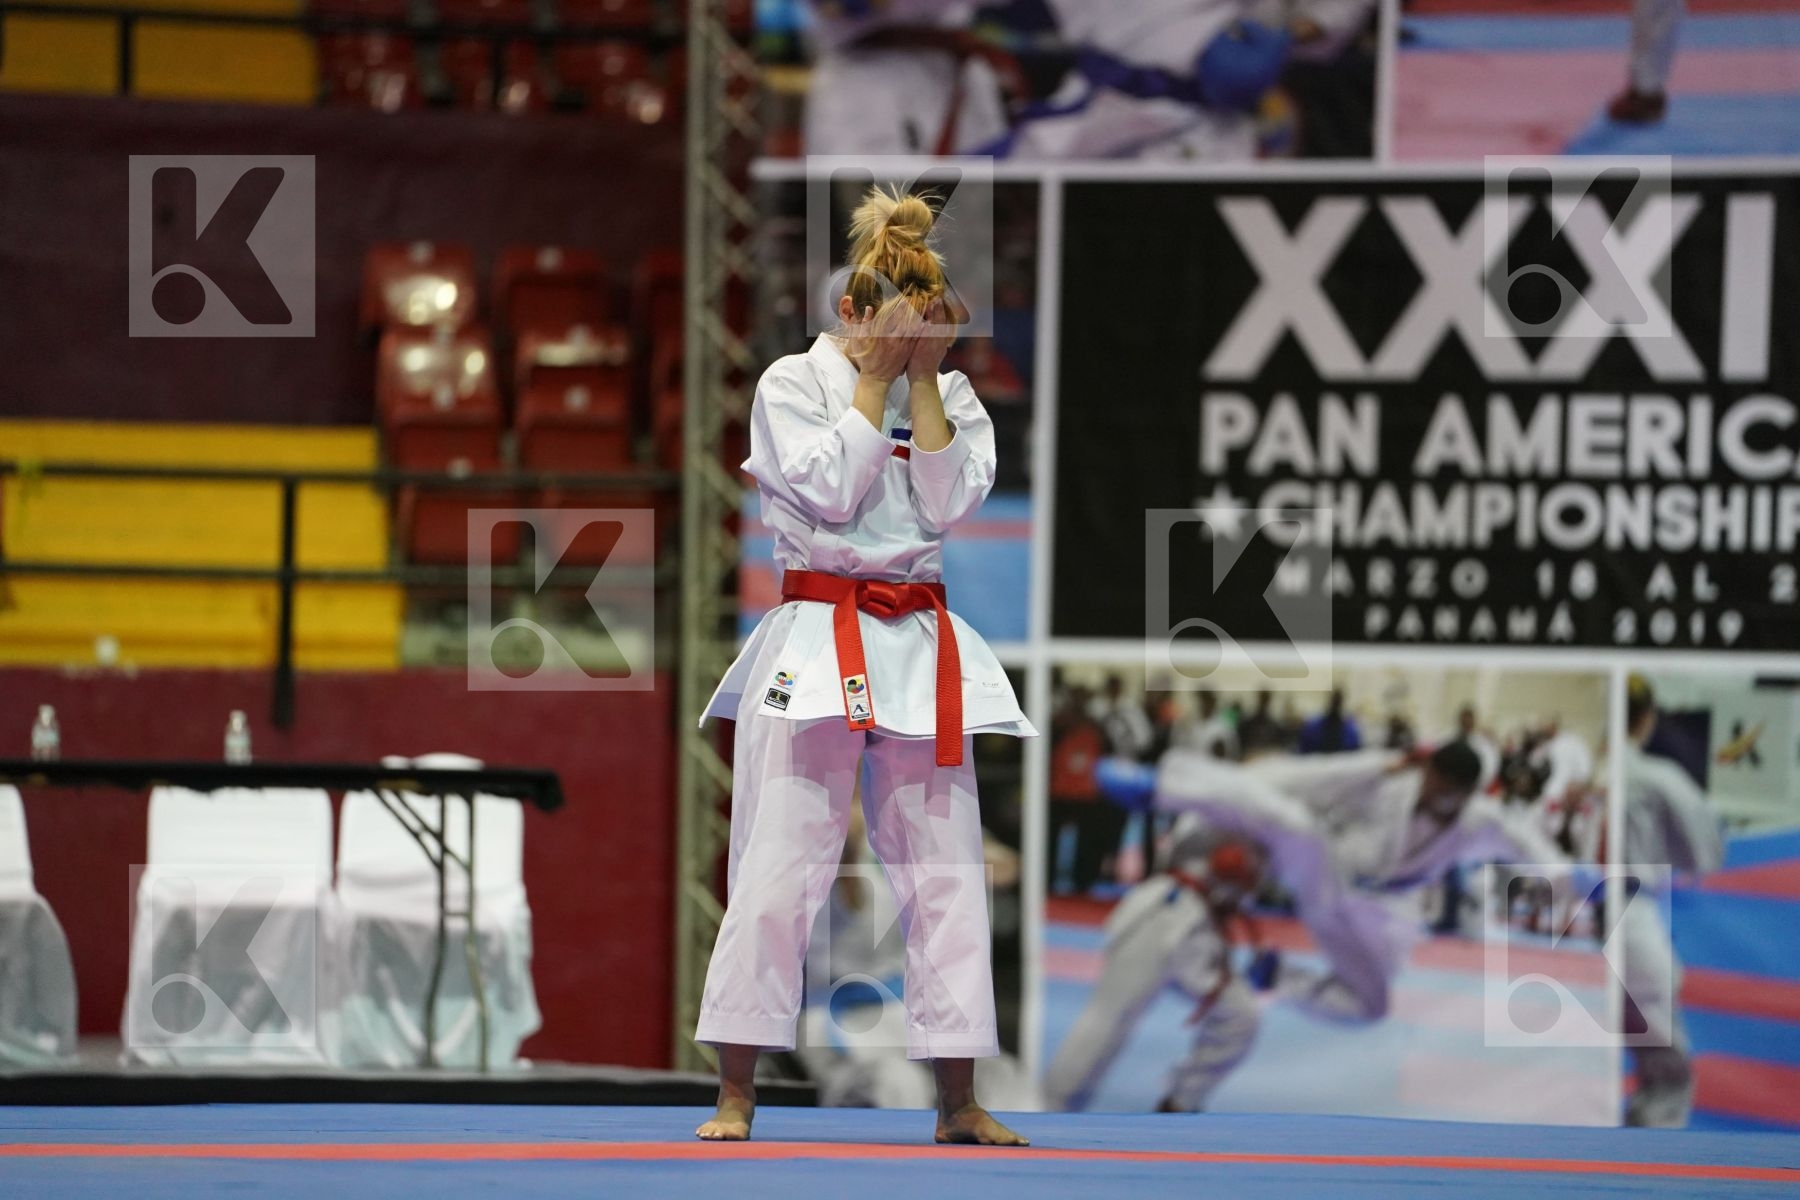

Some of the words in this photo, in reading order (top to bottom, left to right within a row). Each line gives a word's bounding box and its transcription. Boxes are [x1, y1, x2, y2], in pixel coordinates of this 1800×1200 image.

[1203, 194, 1774, 380] XXXI
[1200, 393, 1380, 475] PAN
[1414, 393, 1800, 479] AMERIC
[1273, 557, 1489, 598] MARZO
[1646, 561, 1718, 602] AL
[1613, 607, 1744, 644] 2019
